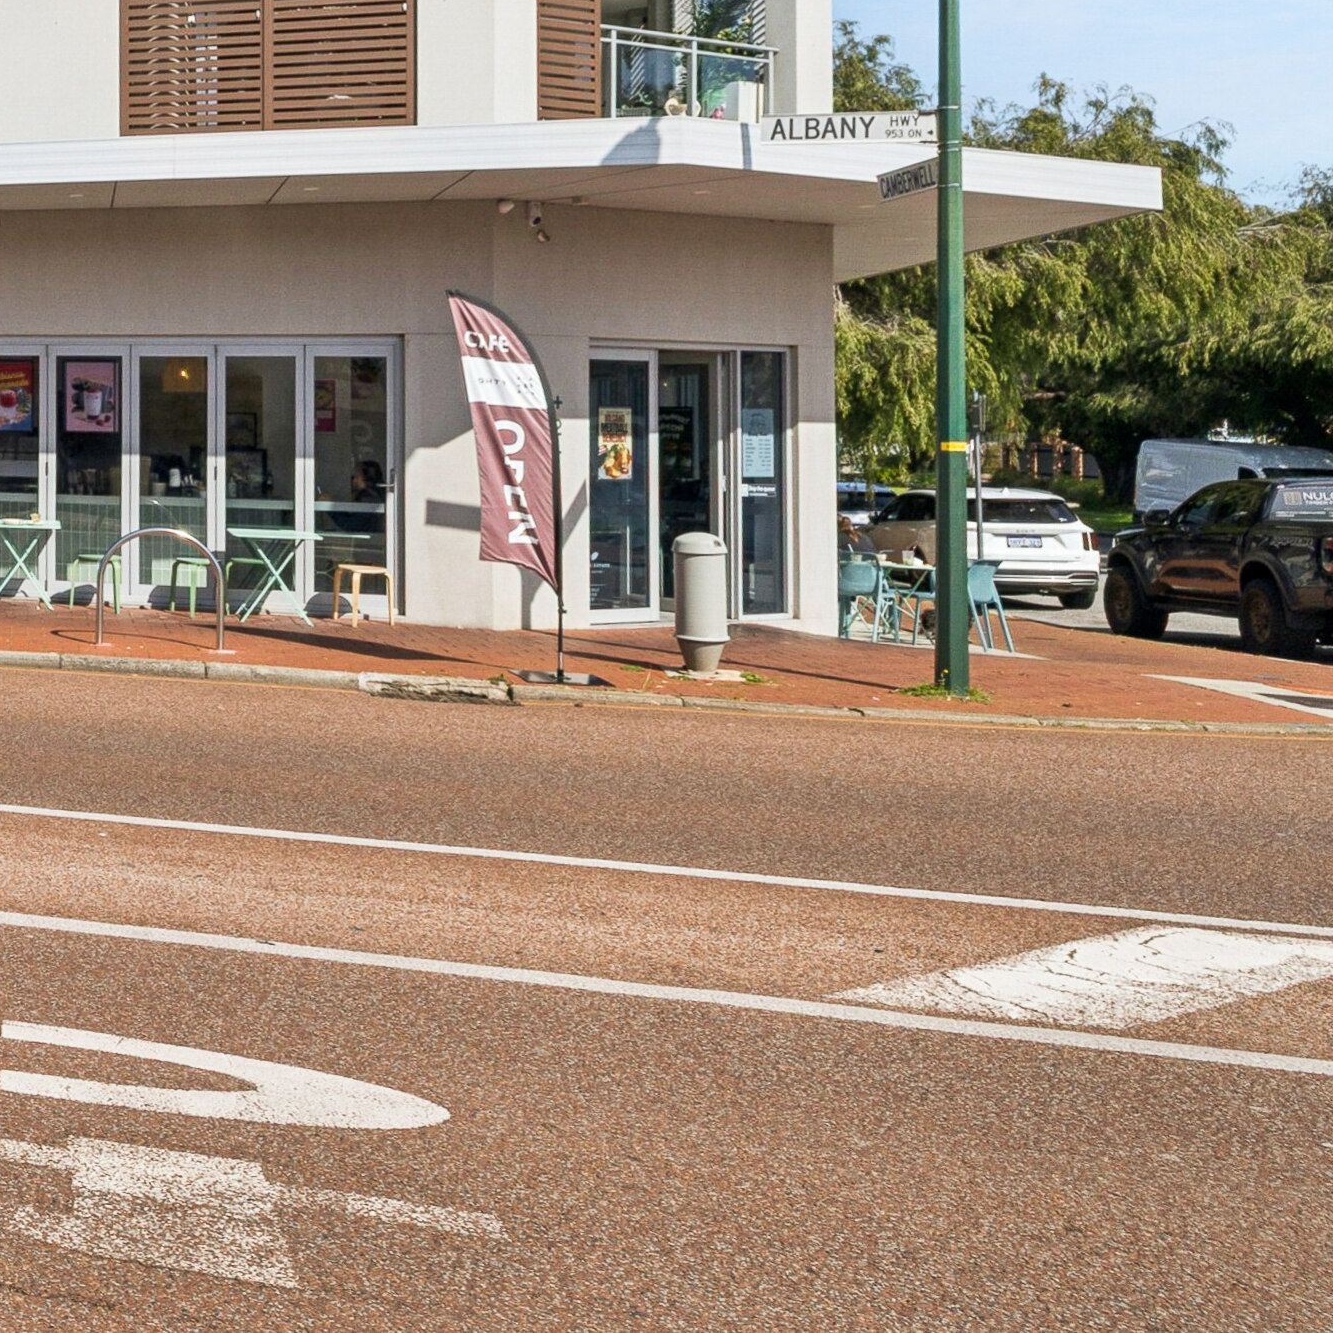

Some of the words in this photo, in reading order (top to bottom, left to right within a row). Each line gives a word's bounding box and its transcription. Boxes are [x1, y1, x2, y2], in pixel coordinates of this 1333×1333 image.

[770, 116, 875, 140] ALBANY
[889, 115, 920, 127] HWY
[885, 129, 904, 138] 953
[907, 129, 922, 137] ON
[880, 164, 936, 199] CAMBERWELL
[494, 419, 539, 545] OPEN
